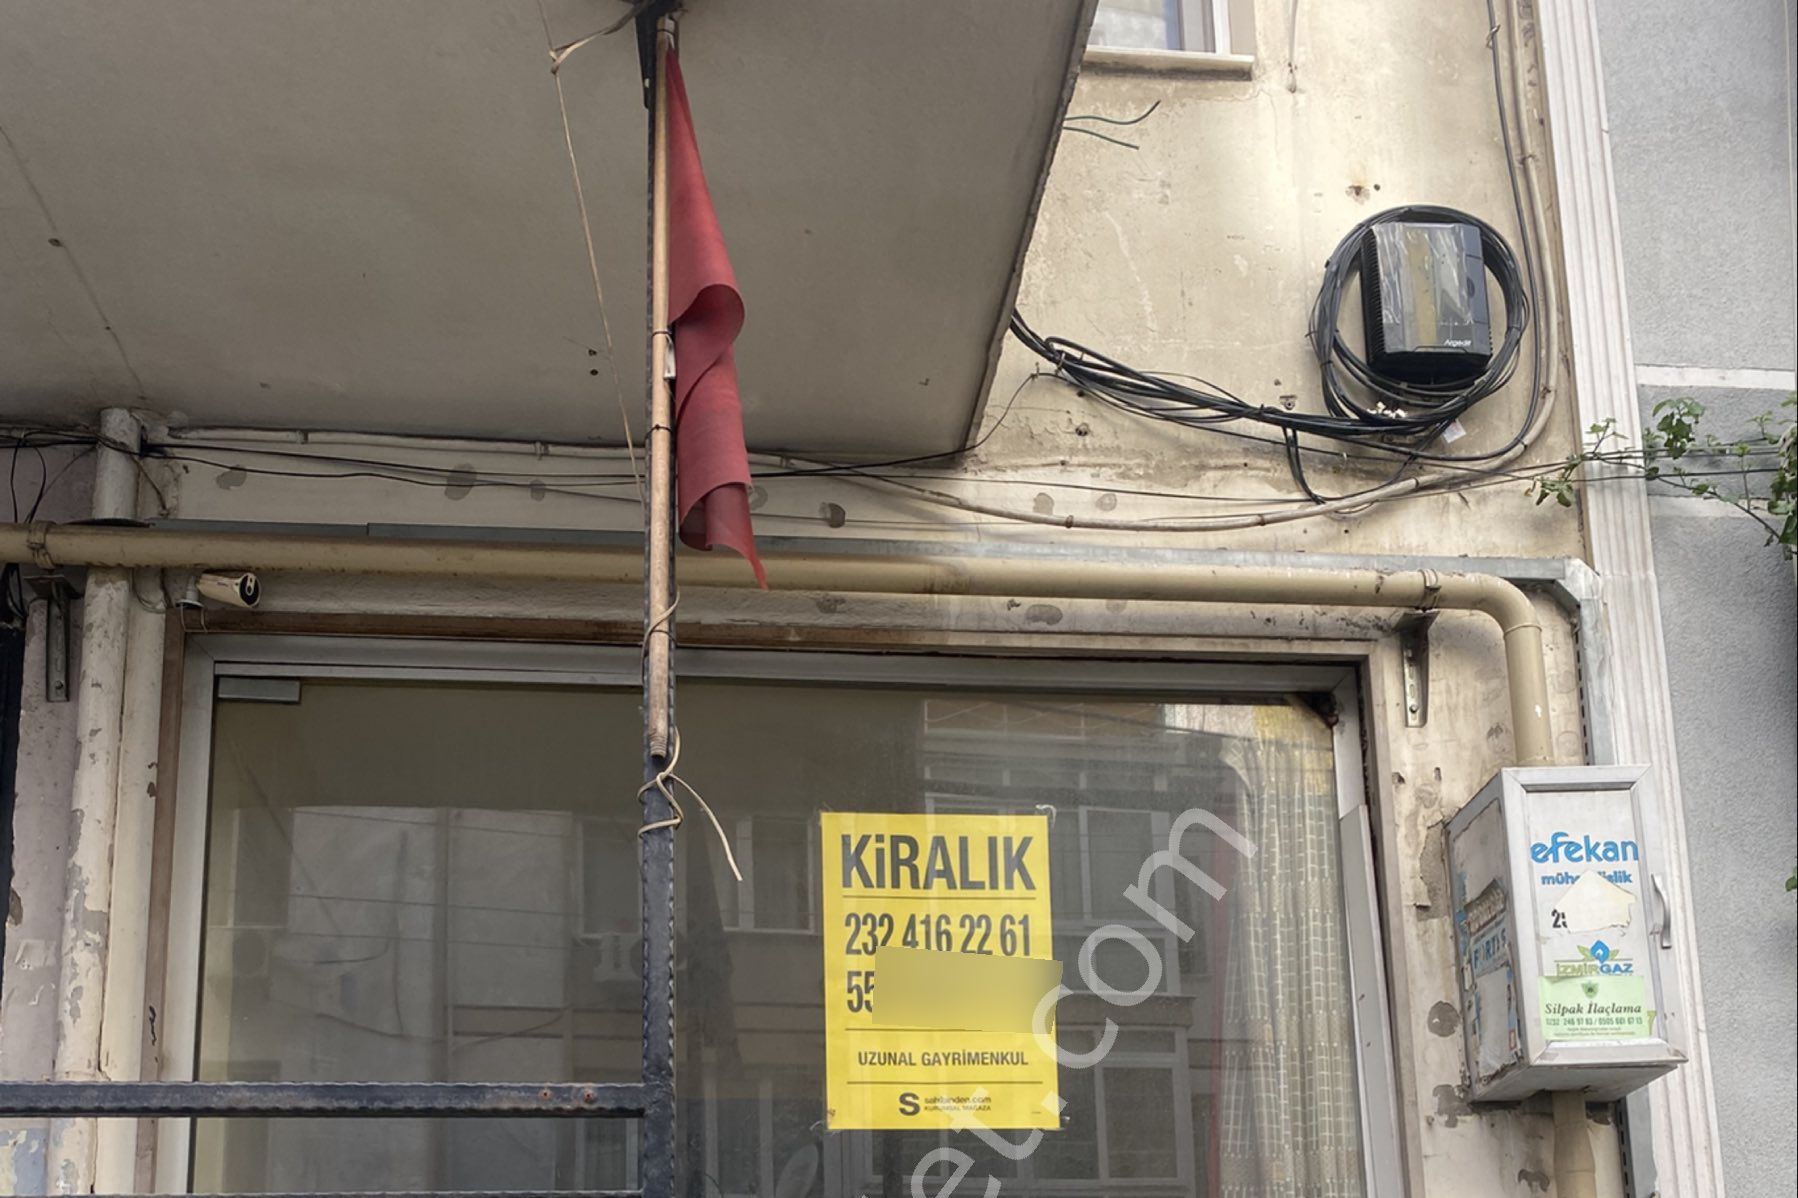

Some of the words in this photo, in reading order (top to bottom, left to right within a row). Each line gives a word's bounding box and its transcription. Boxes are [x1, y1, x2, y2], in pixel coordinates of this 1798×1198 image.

[1530, 831, 1639, 863] efekan
[844, 912, 895, 956] 232
[902, 913, 953, 952] 416
[959, 914, 993, 956] 22
[1000, 914, 1031, 957] 61
[1544, 1003, 1583, 1017] Silpak
[1587, 1001, 1641, 1016] İlaçlama
[858, 1051, 917, 1066] UZUNAL
[921, 1049, 1029, 1067] GAYRİMENKUL
